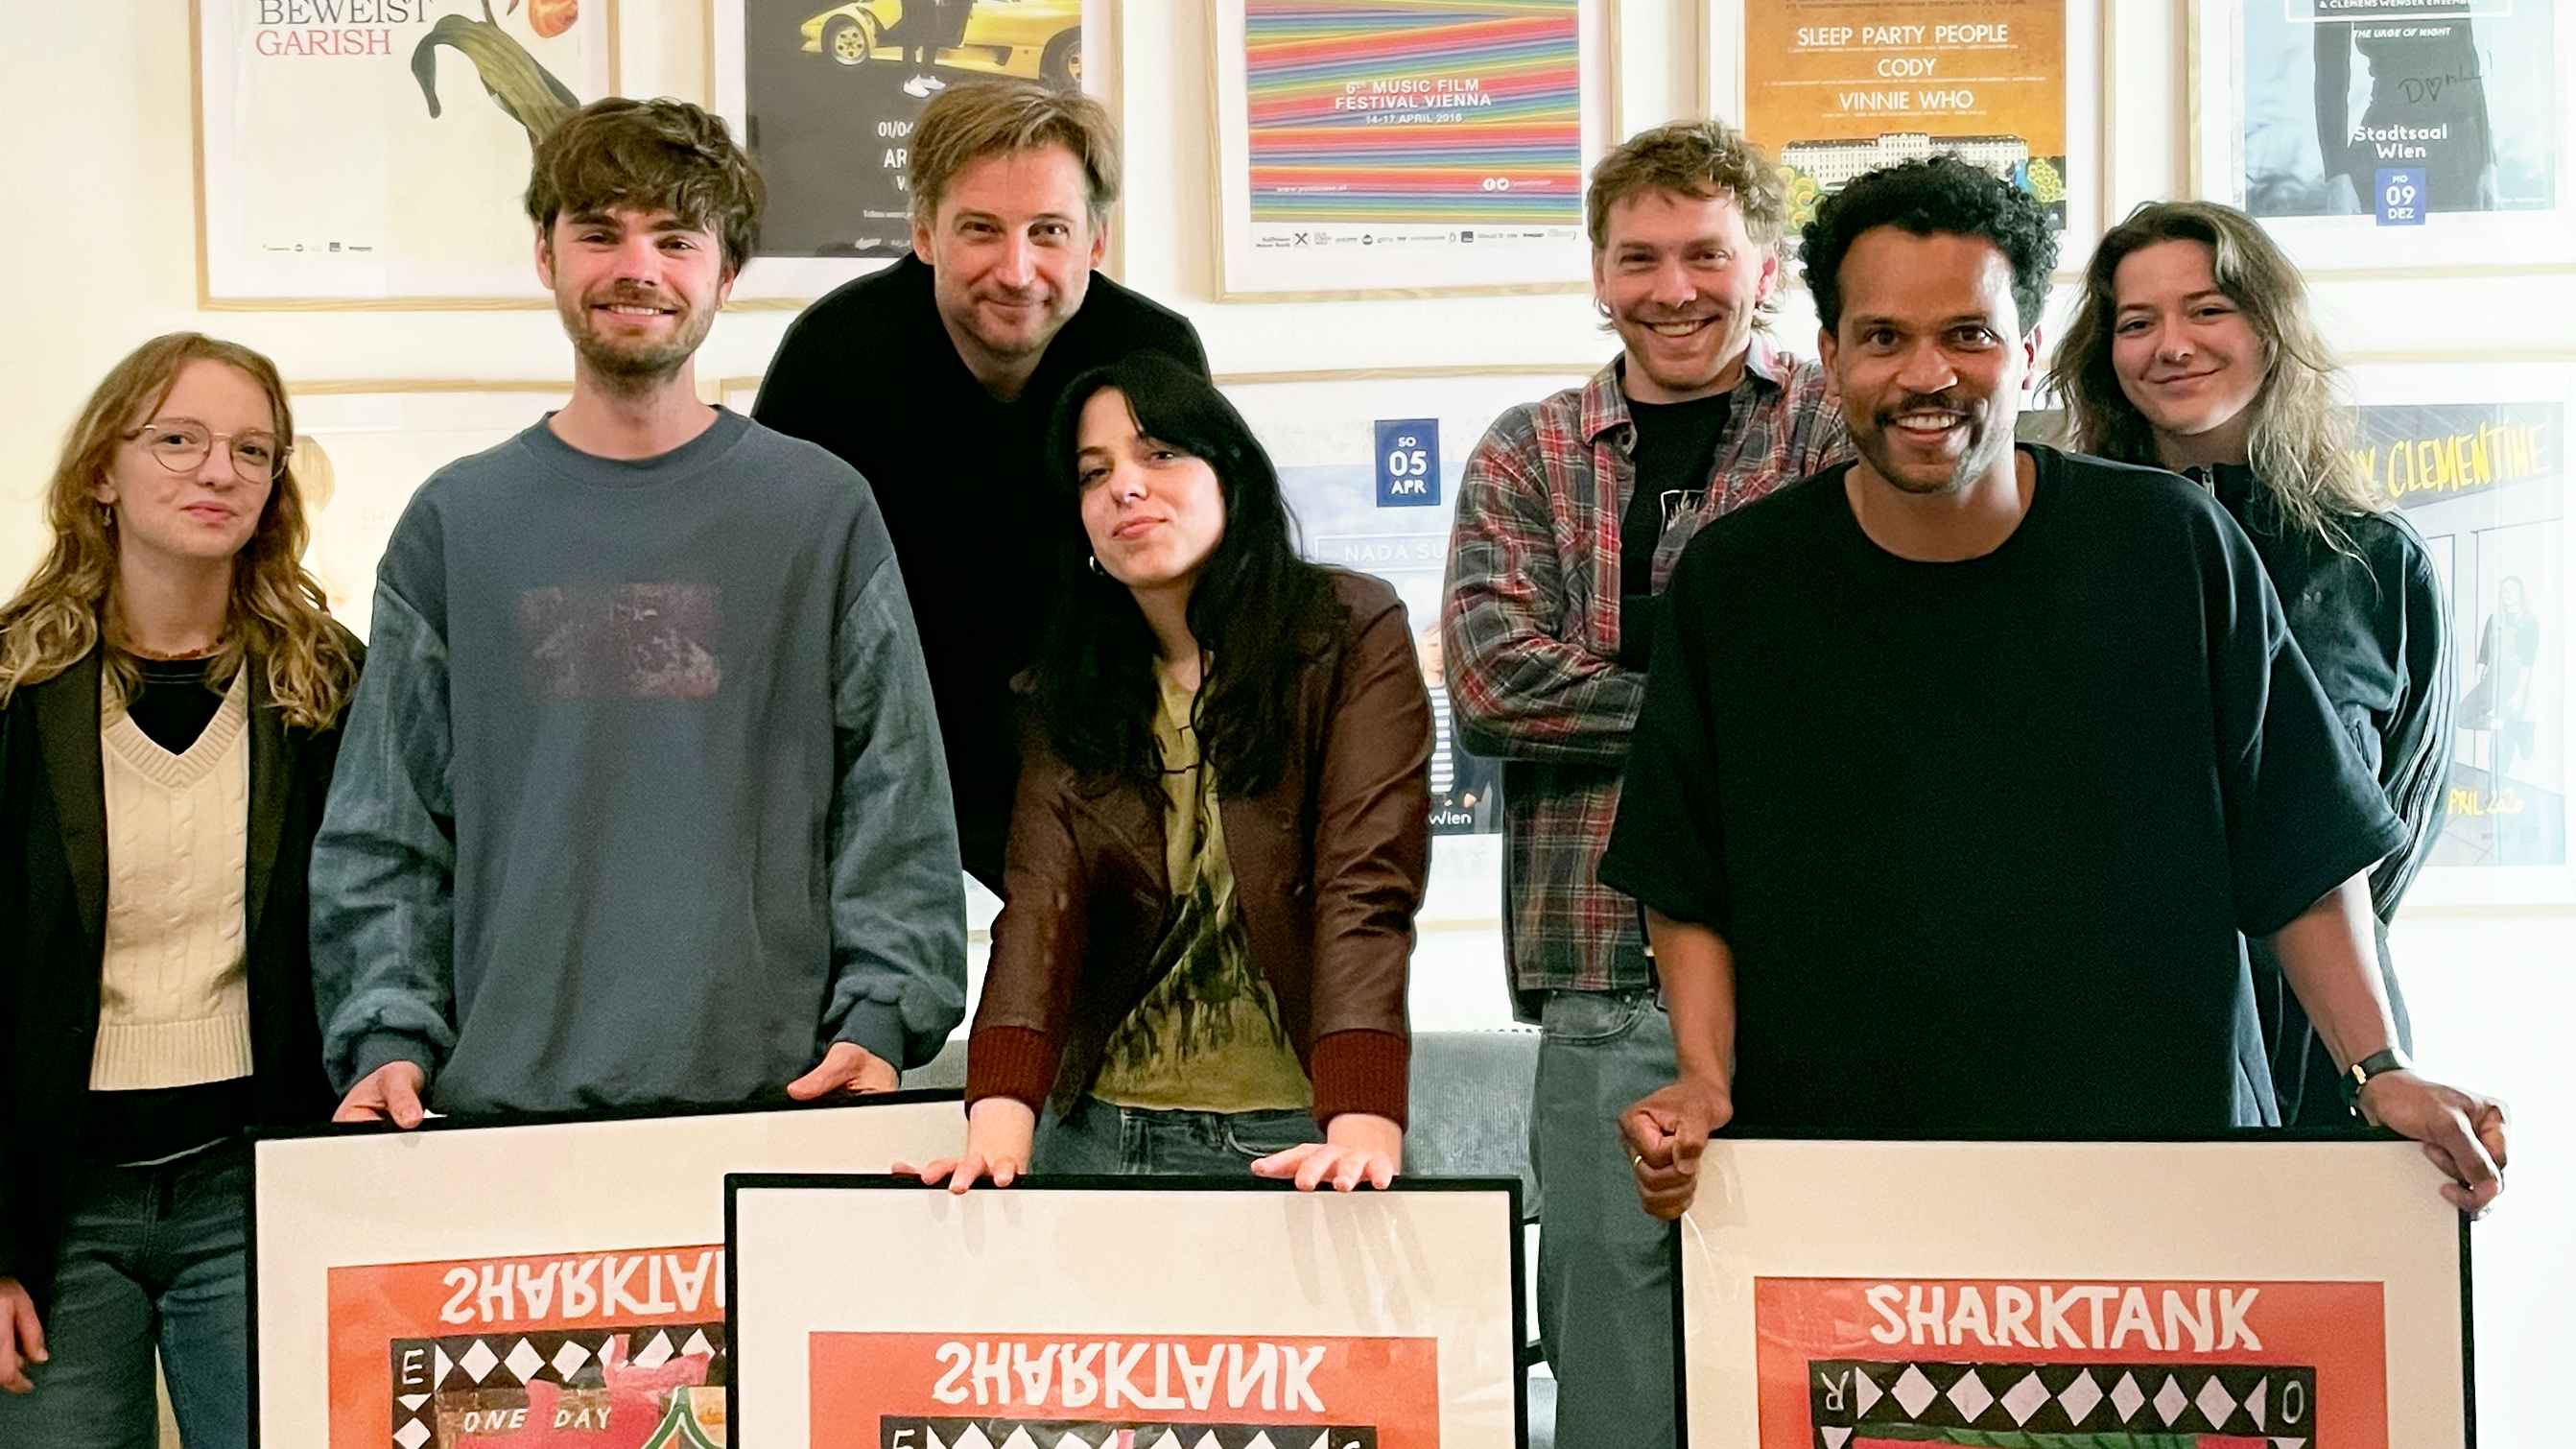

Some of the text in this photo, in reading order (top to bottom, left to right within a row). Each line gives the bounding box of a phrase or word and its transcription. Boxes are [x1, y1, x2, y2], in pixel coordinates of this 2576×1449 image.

[258, 0, 435, 25] BEWEIST
[1797, 23, 2009, 46] SLEEP PARTY PEOPLE
[2402, 27, 2419, 37] OF
[255, 29, 392, 56] GARISH
[1877, 58, 1937, 78] CODY
[1373, 80, 1430, 94] MUSIC
[1437, 78, 1479, 92] FILM
[1335, 93, 1492, 110] FESTIVAL VIENNA
[1838, 89, 1974, 111] VINNIE WHO
[1397, 113, 1433, 124] APRIL
[2353, 123, 2447, 142] Stadtsaal
[2375, 143, 2426, 159] Wien
[2386, 185, 2416, 206] 09
[2388, 207, 2415, 220] DEZ
[1398, 436, 1417, 448] SO
[1388, 450, 1428, 477] 05
[2387, 421, 2550, 498] CLEMENTINE
[1391, 479, 1428, 494] APR
[1344, 542, 1447, 561] NADA SU
[1429, 810, 1472, 825] Wien
[1865, 1284, 2263, 1352] SHARKTANK
[463, 1405, 613, 1434] ONE DAY
